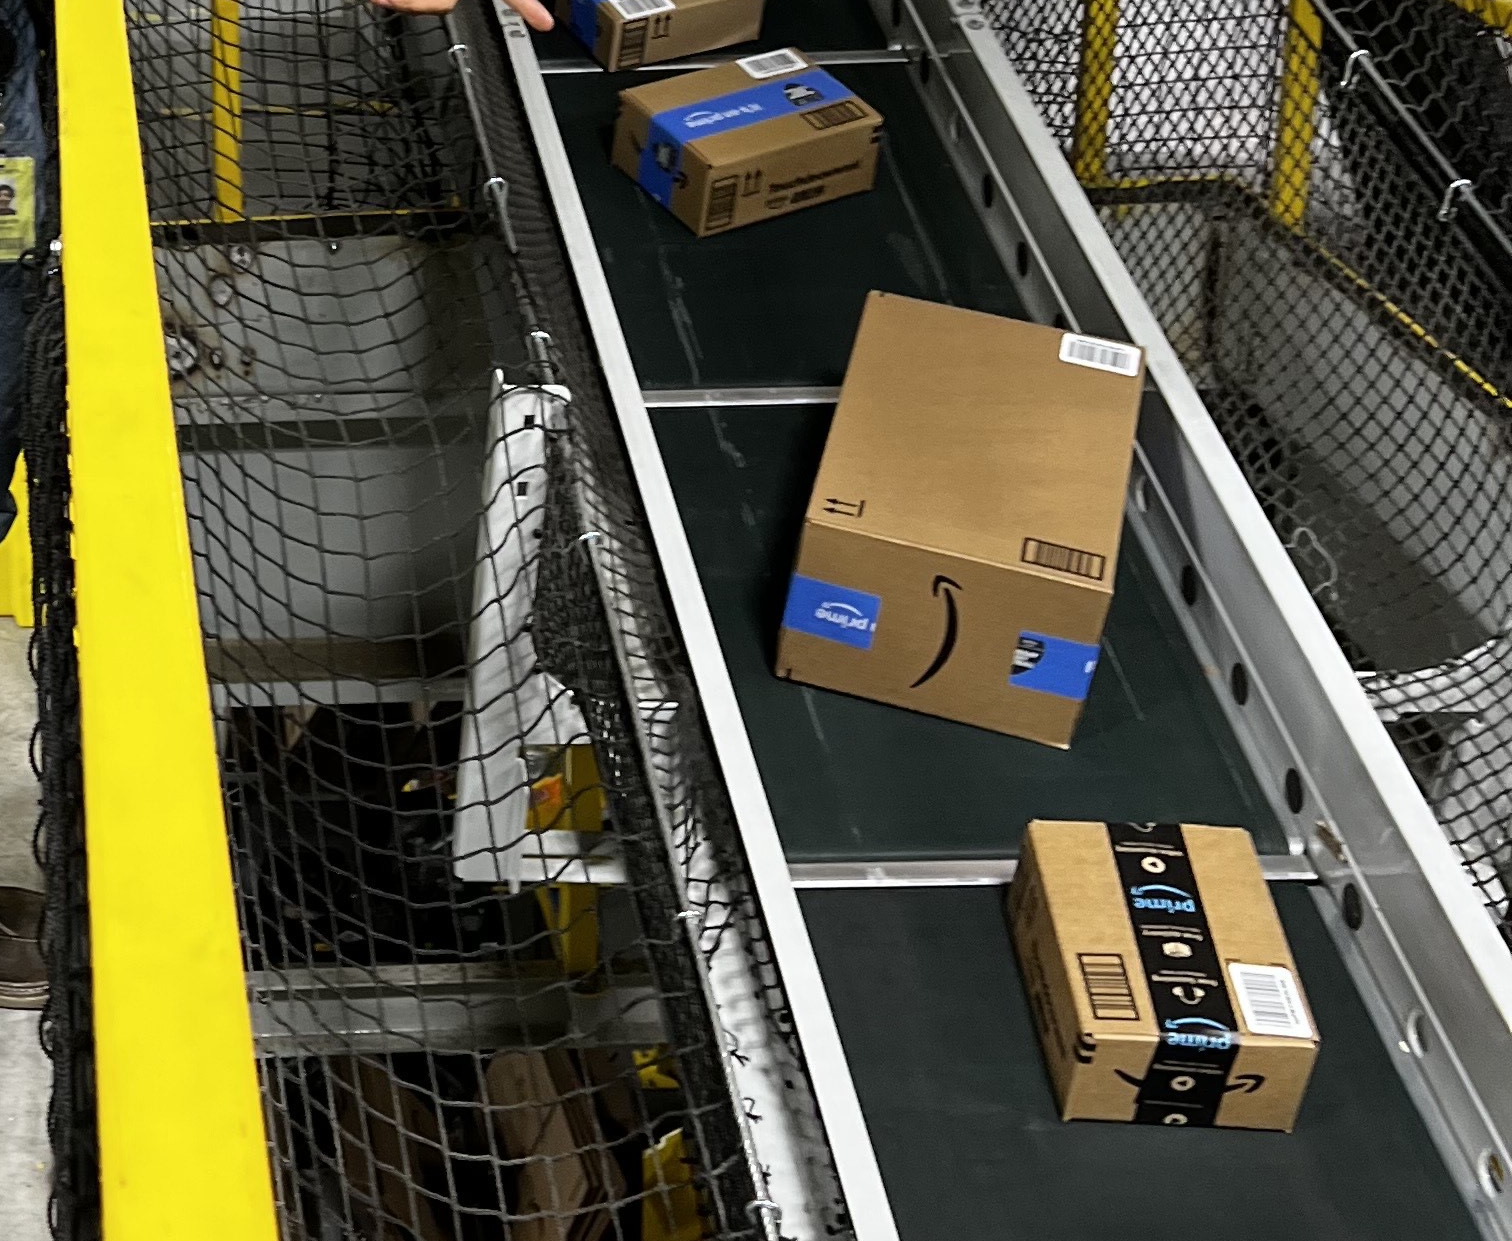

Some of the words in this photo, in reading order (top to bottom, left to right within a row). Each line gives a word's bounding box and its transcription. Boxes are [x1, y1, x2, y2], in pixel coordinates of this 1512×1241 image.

[814, 607, 870, 630] prime
[1133, 896, 1196, 914] prime
[1167, 1030, 1234, 1052] prime
